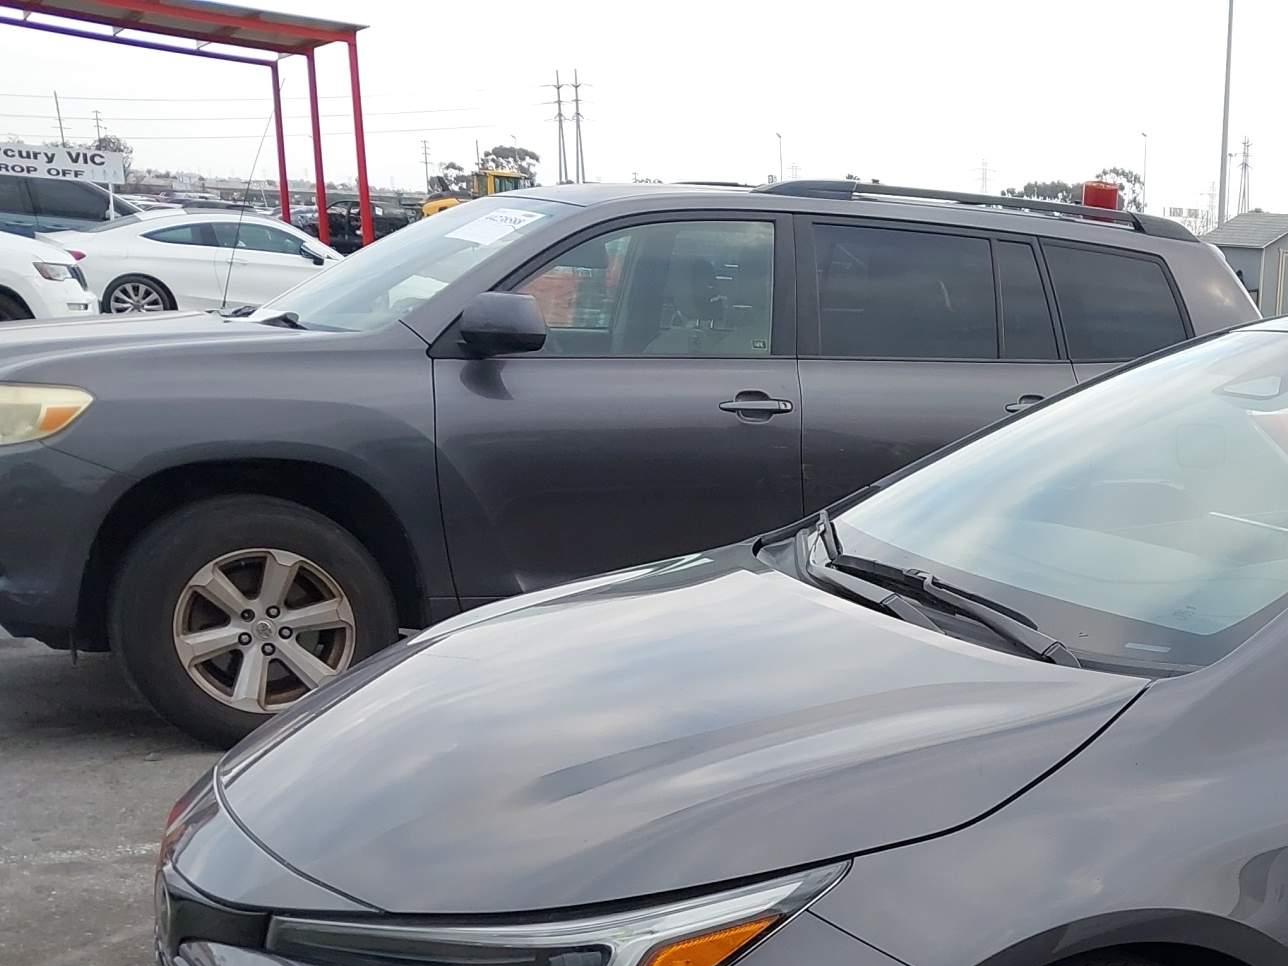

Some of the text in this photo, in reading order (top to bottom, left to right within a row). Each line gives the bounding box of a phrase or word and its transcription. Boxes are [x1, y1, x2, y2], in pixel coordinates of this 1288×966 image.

[0, 148, 106, 166] cury VIC
[46, 167, 85, 178] OFF
